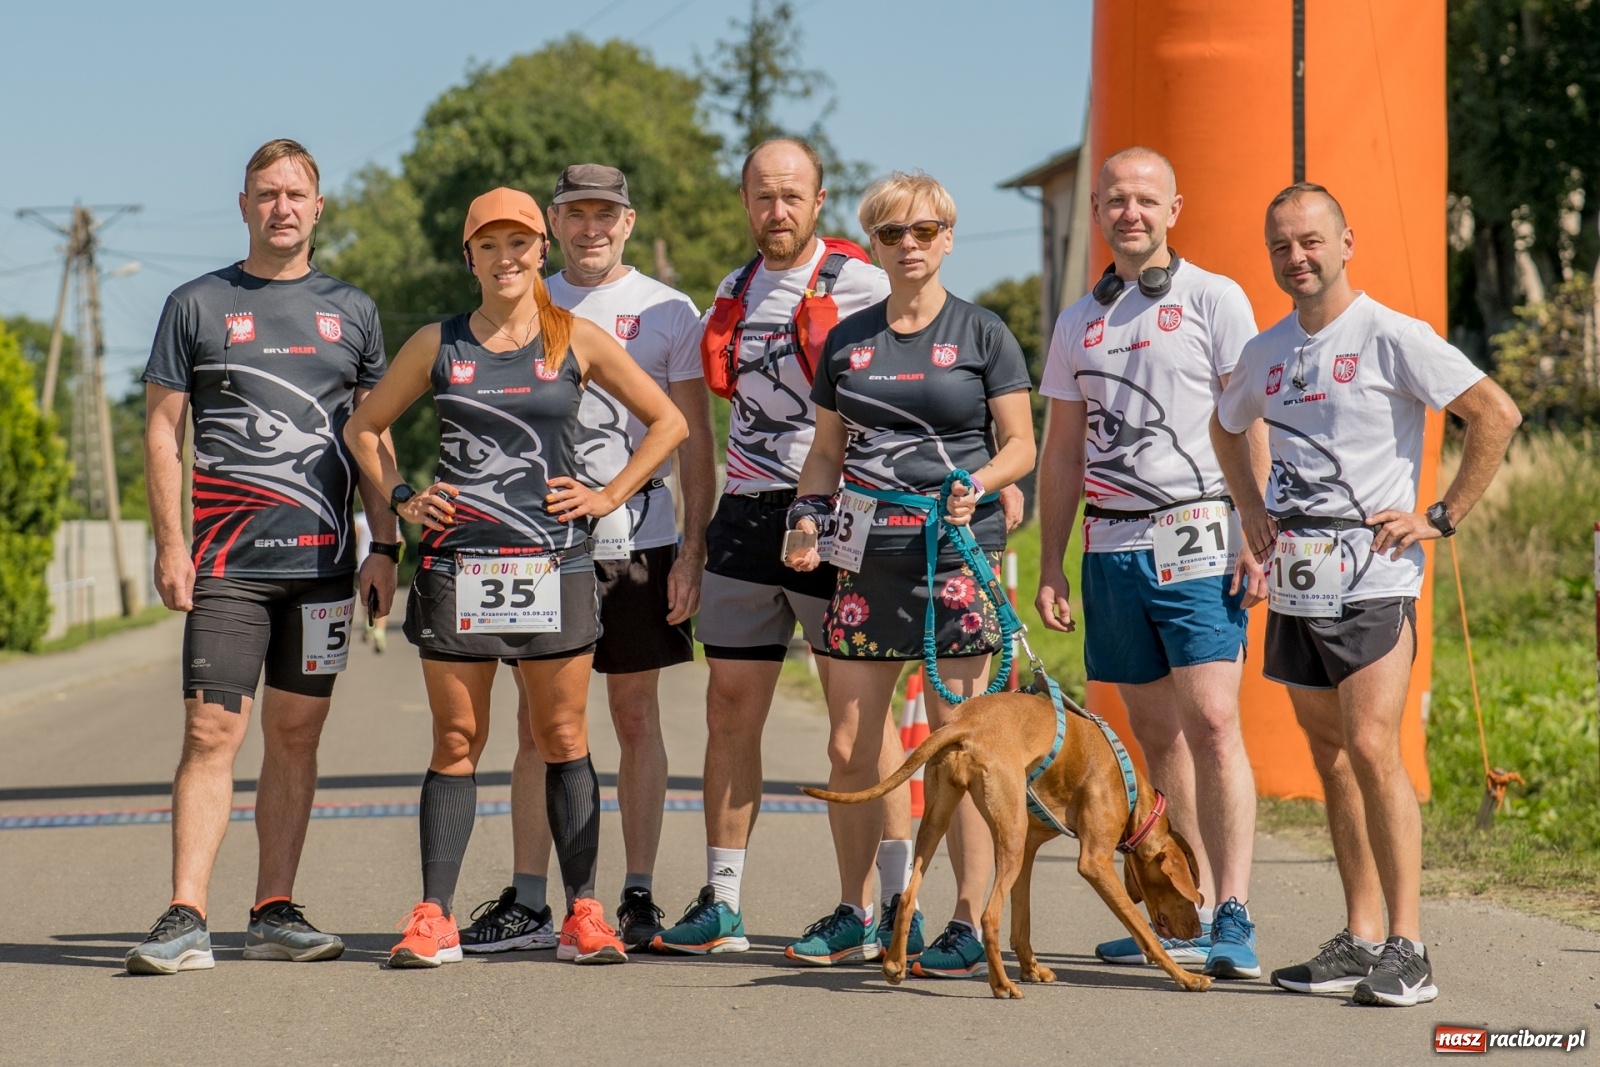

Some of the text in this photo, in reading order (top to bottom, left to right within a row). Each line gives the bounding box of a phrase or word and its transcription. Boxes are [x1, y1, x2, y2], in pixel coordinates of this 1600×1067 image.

[1159, 507, 1209, 527] COLOUR
[1175, 522, 1225, 557] 21
[463, 563, 551, 576] COLOUR RUN
[1275, 556, 1316, 591] 16
[480, 578, 536, 609] 35
[327, 619, 349, 650] 5
